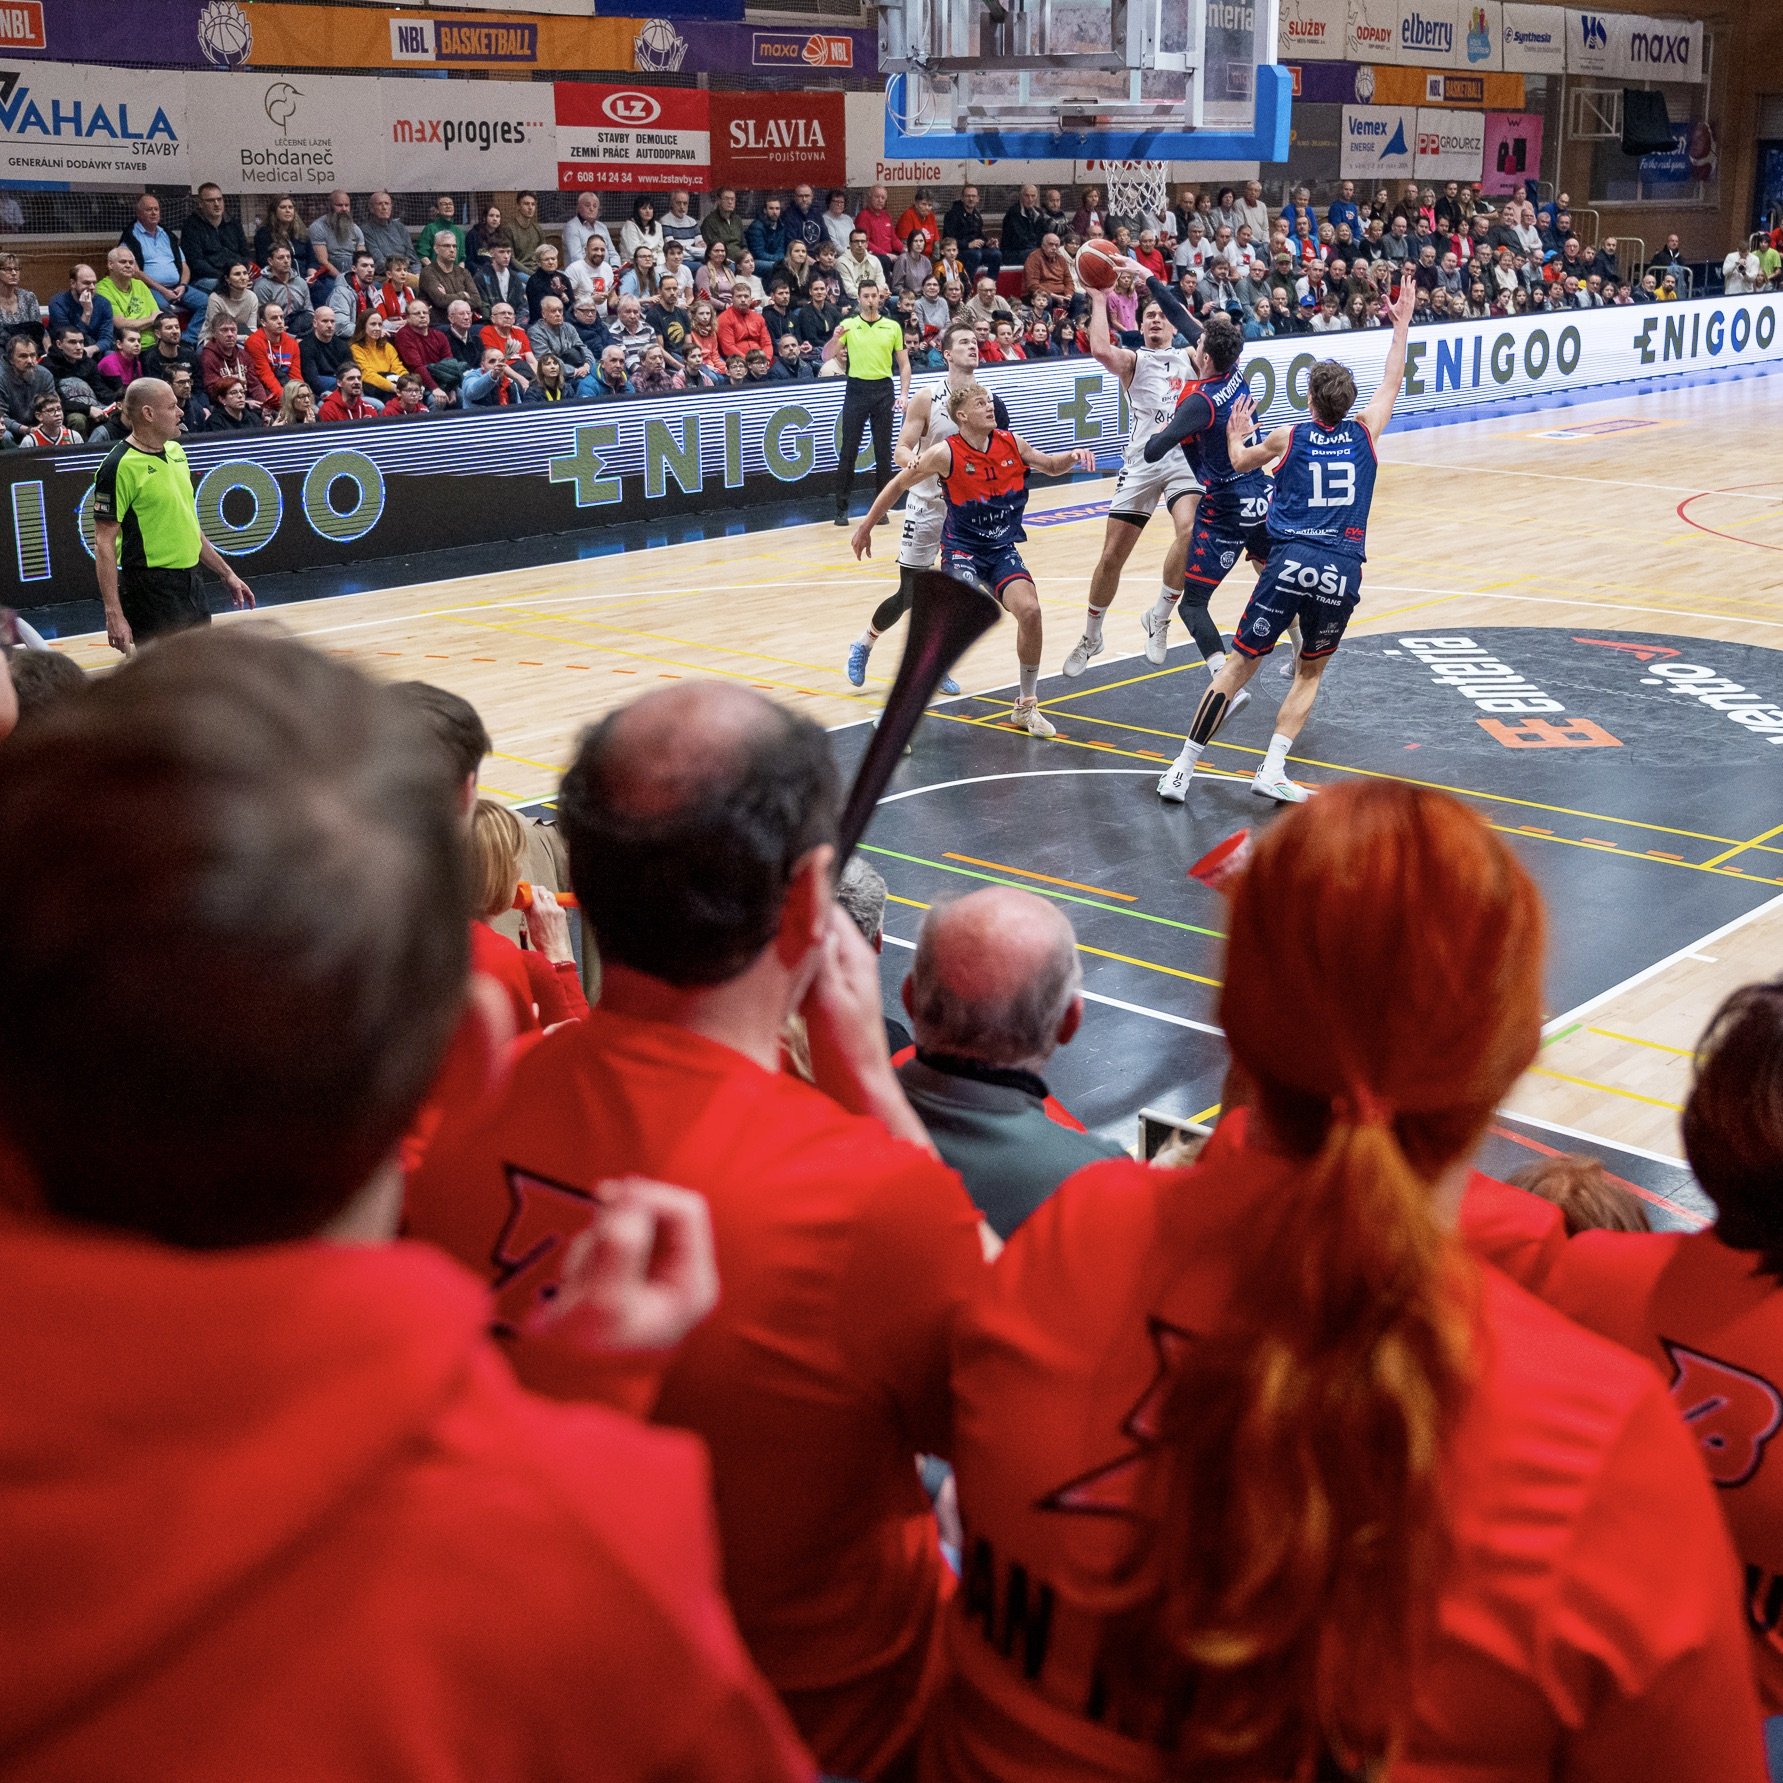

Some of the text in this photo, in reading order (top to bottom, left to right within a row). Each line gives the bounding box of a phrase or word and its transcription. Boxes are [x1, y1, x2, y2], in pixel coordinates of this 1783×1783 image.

[1206, 0, 1254, 32] nteria
[0, 13, 36, 39] NBL
[1289, 19, 1326, 36] SLUŽBY
[1356, 26, 1392, 43] ODPADY
[1402, 12, 1453, 53] elberry
[398, 25, 531, 55] NBL BASKETBALL
[1513, 31, 1552, 44] Synthesia
[760, 42, 848, 61] maxa NBL
[1631, 32, 1690, 65] maxa
[0, 87, 178, 141] VAHALA
[616, 100, 647, 117] LZ
[730, 119, 825, 149] SLAVIA
[1349, 115, 1387, 136] Vemex
[274, 138, 307, 147] LÉČEBNÉ
[392, 120, 525, 151] maxprogres
[598, 133, 678, 146] STAVBY DEMOLICE
[132, 142, 180, 156] STAVBY
[570, 146, 696, 160] ZEMNÍ PRÁCE AUTODOPRAVA
[1351, 142, 1375, 152] ENERGIE
[8, 156, 147, 171] GENERÁLNÍ DODÁVKY STAVEB
[241, 149, 334, 166] Bohdaneč
[769, 151, 826, 162] POJIŠŤOVNA
[242, 168, 335, 185] Medical Spa
[577, 172, 703, 186] 608 14 24 34 www.lzstavby.cz
[876, 161, 941, 182] Pardubice
[1634, 305, 1775, 365] ENIGOO
[1405, 325, 1581, 396] ENIGOO
[1309, 431, 1353, 445] KEJVAL
[1312, 448, 1351, 456] pumpa
[984, 467, 998, 481] 11
[1308, 461, 1356, 507] 13
[11, 448, 386, 582] IOO
[1277, 559, 1347, 597] ZOŠI
[1315, 594, 1342, 606] TRANS
[1383, 637, 1565, 713] enteria
